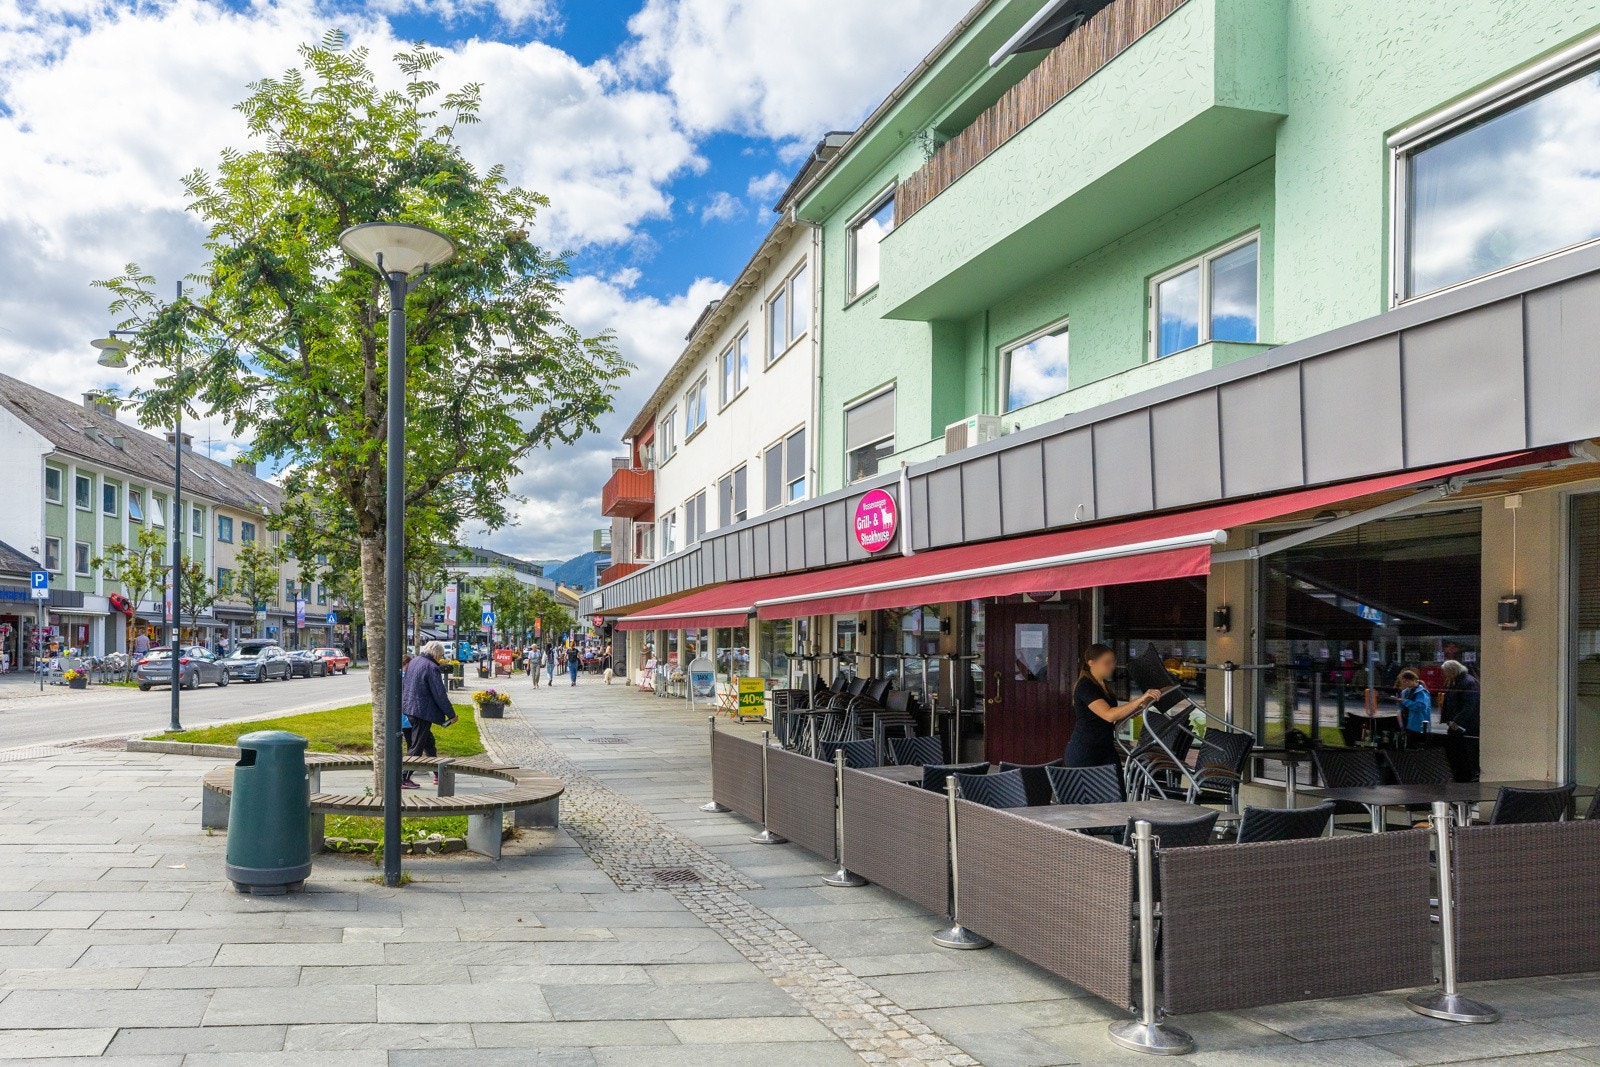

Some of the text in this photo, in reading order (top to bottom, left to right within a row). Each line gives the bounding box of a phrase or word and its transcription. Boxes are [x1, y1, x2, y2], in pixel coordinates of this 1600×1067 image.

[857, 513, 879, 530] Grill- &
[861, 530, 889, 545] Steakhouse
[35, 574, 44, 586] P
[739, 694, 764, 704] -40%
